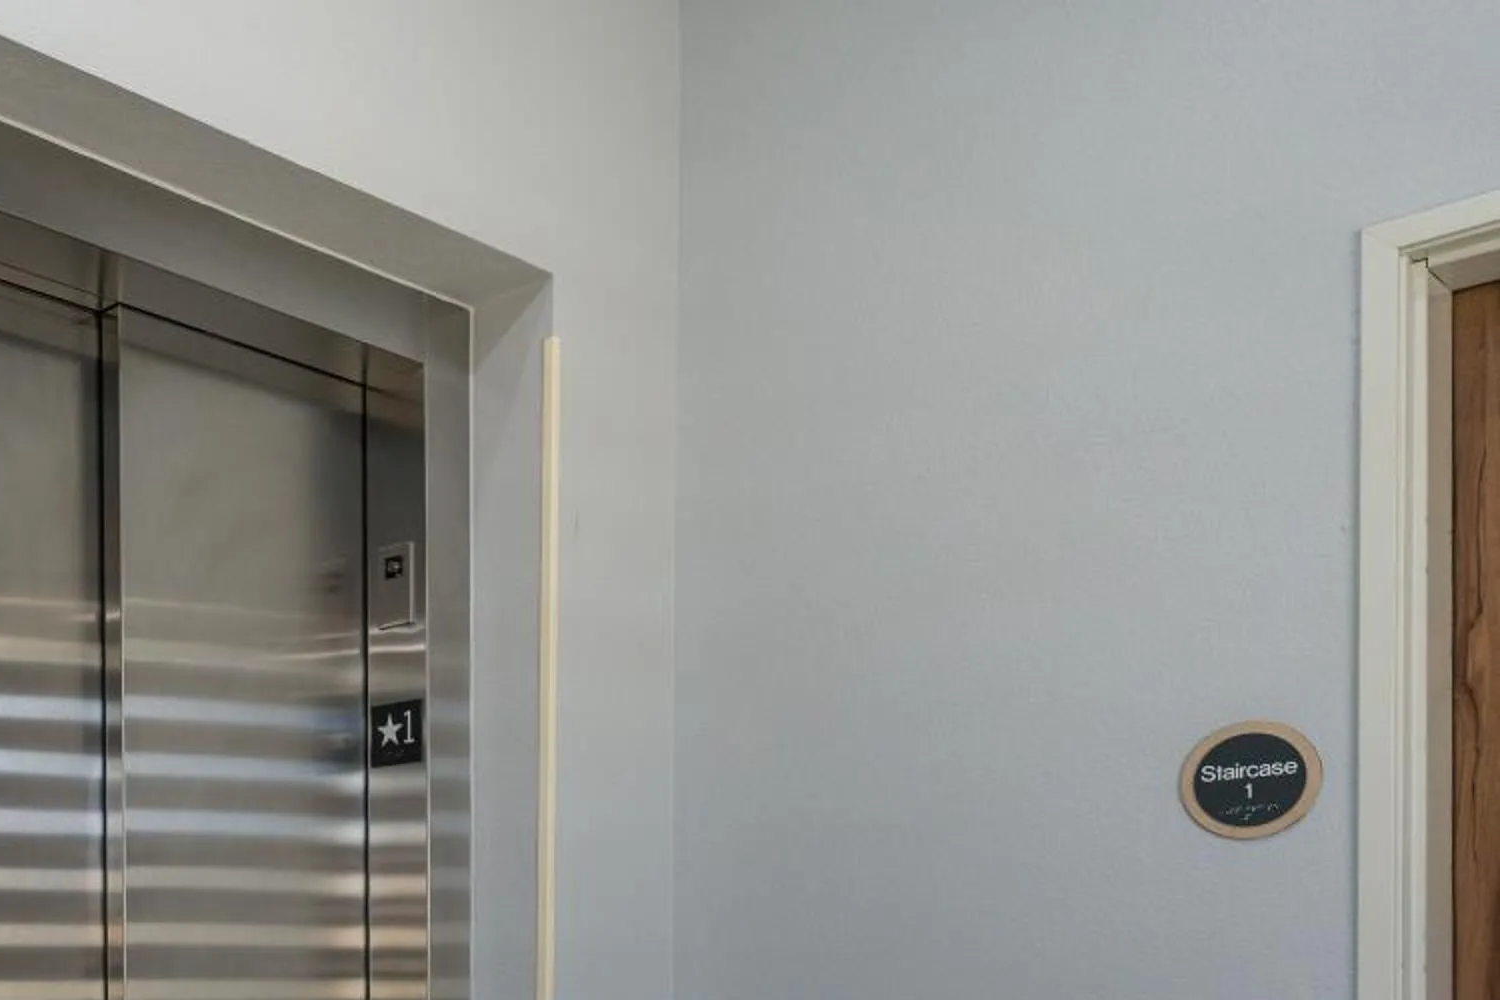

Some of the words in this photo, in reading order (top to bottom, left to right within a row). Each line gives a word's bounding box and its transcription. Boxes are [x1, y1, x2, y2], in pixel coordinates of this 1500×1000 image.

[403, 709, 415, 743] 1
[1200, 760, 1299, 783] Staircase
[1244, 782, 1254, 799] 1
